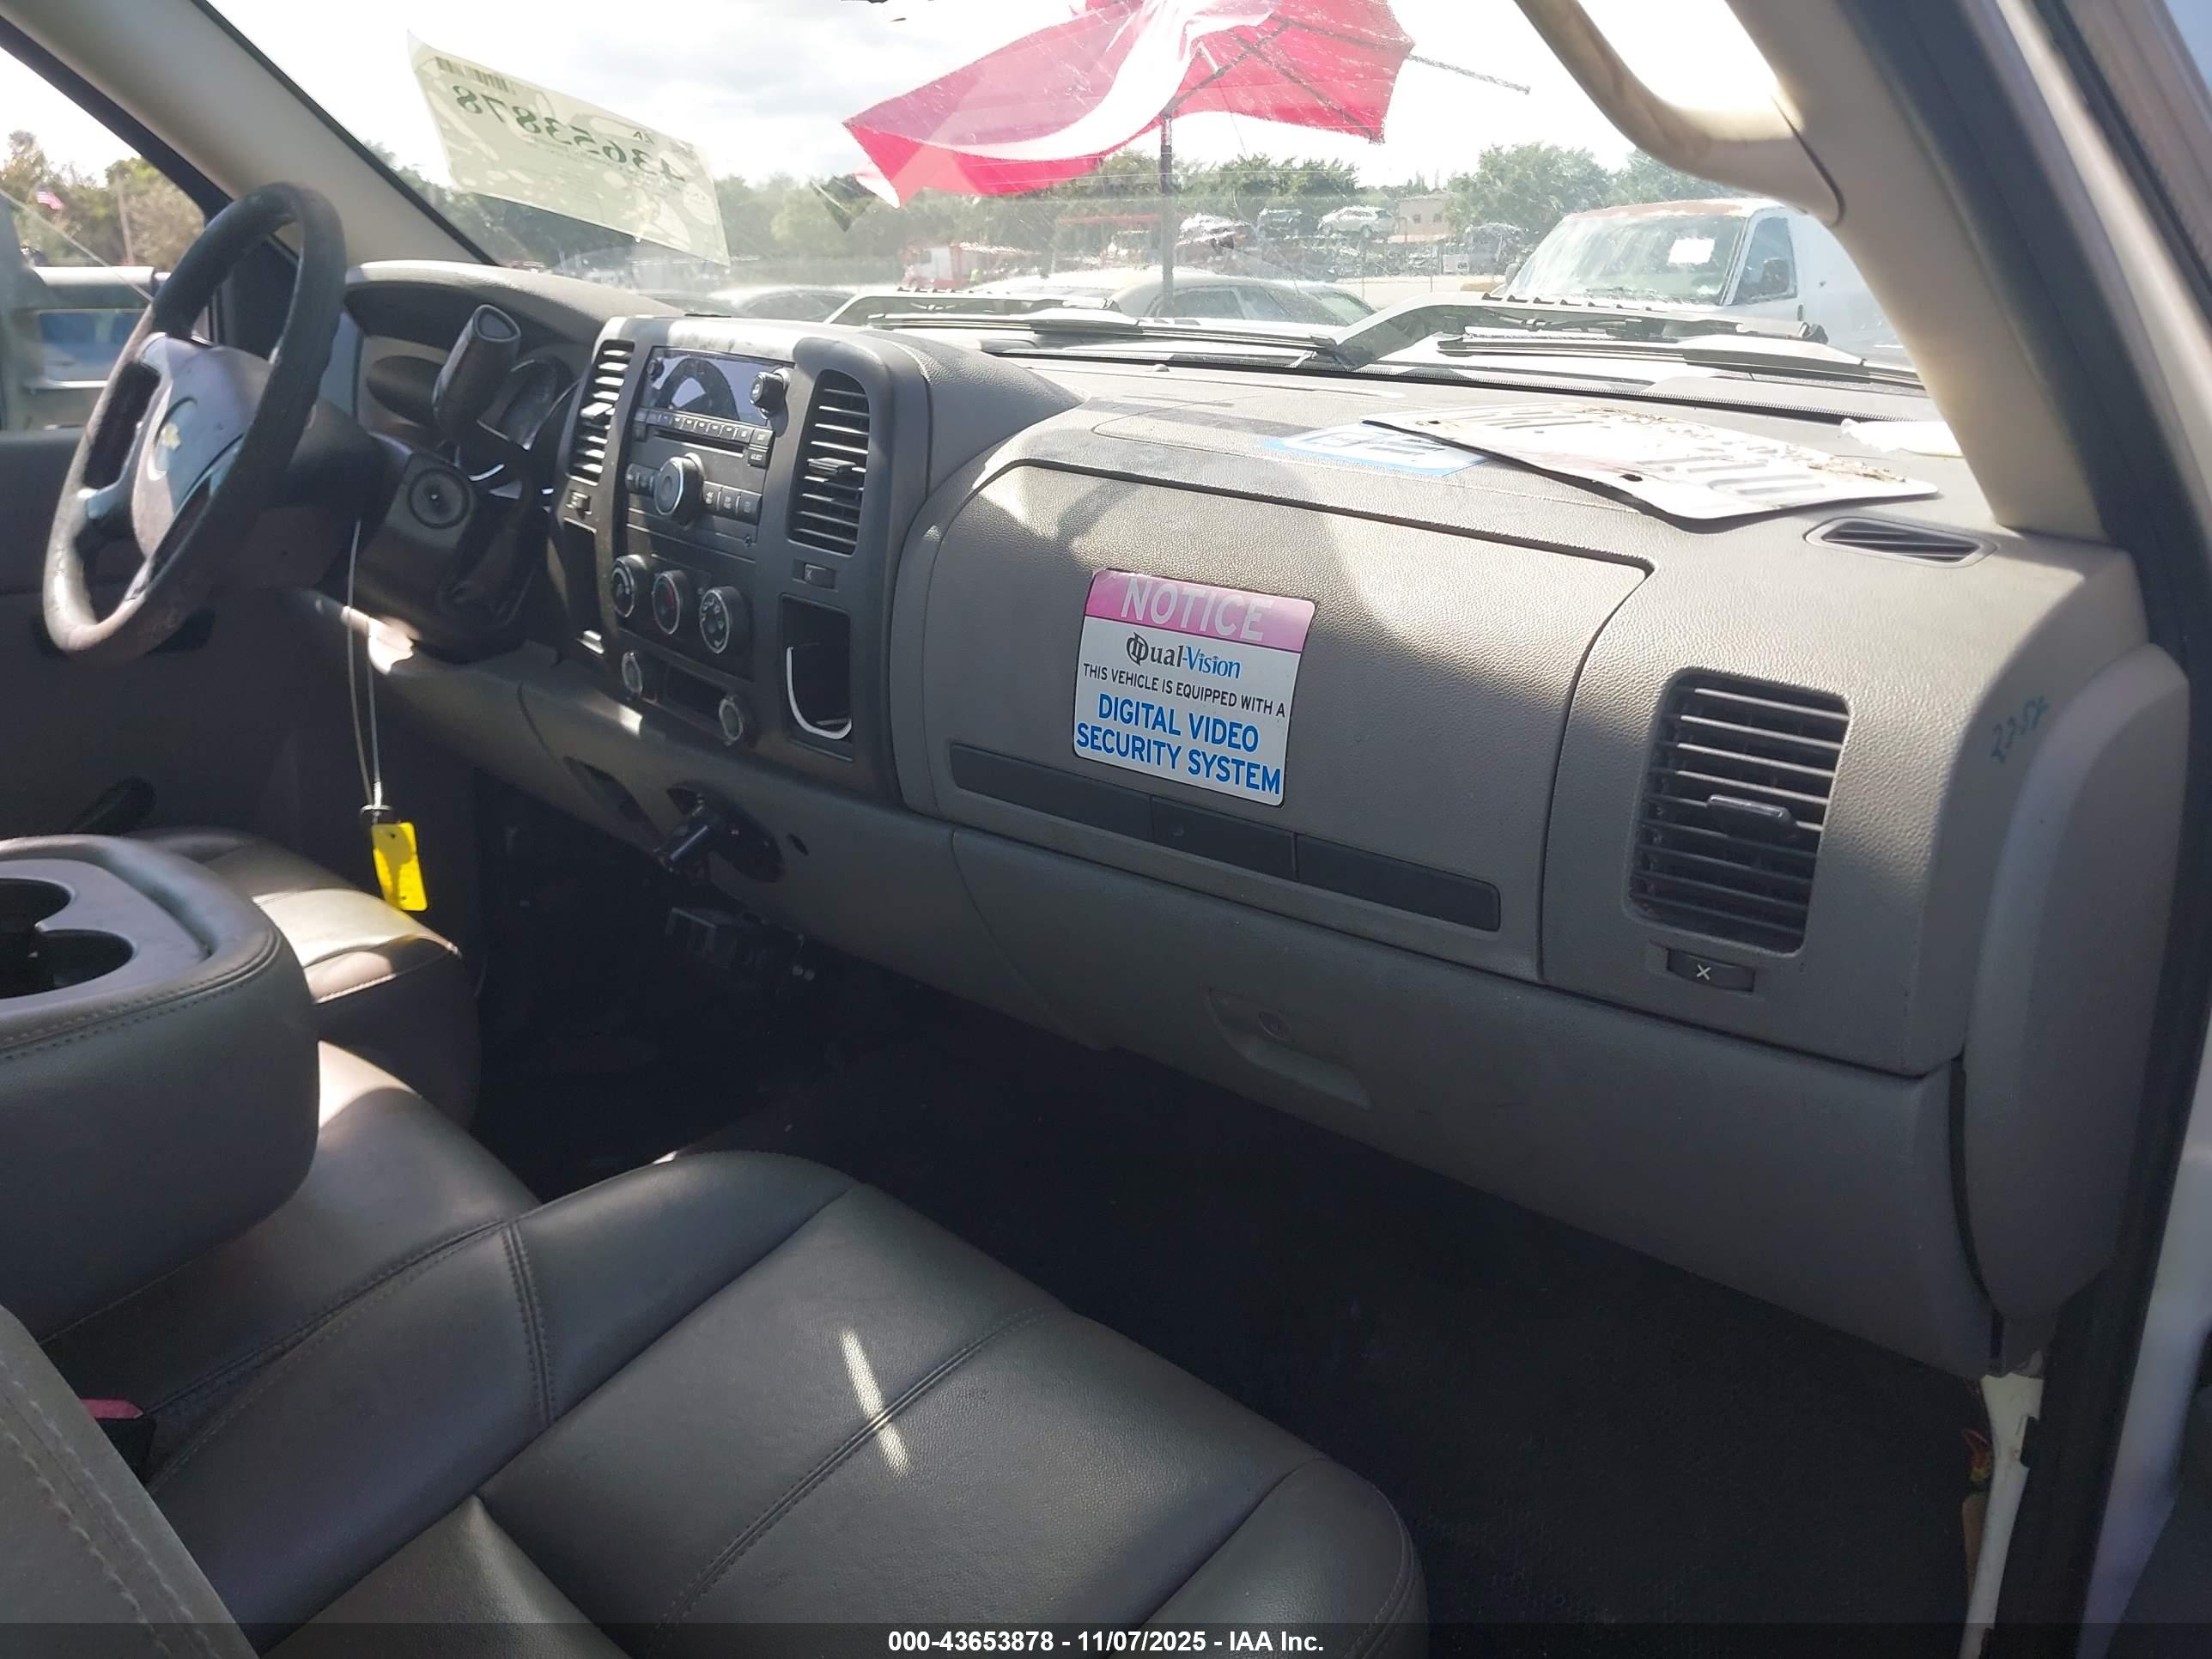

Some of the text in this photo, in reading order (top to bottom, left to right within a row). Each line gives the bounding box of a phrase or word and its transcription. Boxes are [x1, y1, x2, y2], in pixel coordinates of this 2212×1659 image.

[1121, 576, 1273, 641] NOTICE
[1084, 663, 1285, 717] THIS VEHICLE IS EQUIPPED WITH A
[1099, 694, 1258, 752] DIGITAL VIDEO
[1077, 722, 1280, 794] SECURITY SYSTEM
